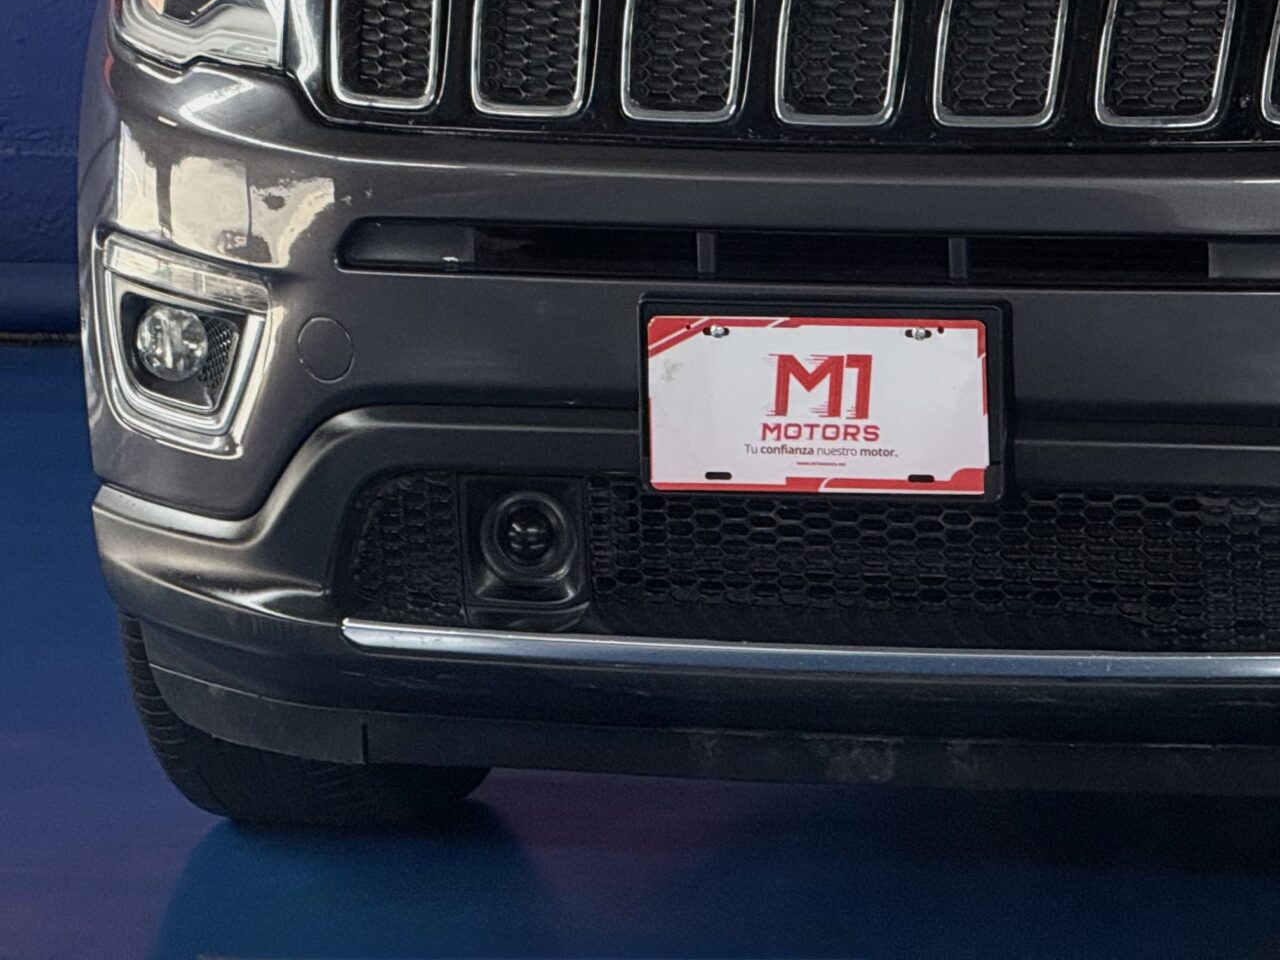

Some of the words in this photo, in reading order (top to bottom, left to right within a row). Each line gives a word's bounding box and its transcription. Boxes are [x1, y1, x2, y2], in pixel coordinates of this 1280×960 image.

[767, 353, 872, 420] M1
[762, 423, 880, 442] MOTORS
[745, 444, 759, 455] Tu
[760, 444, 815, 456] confianza
[817, 446, 858, 457] nuestro
[860, 448, 898, 458] motor.
